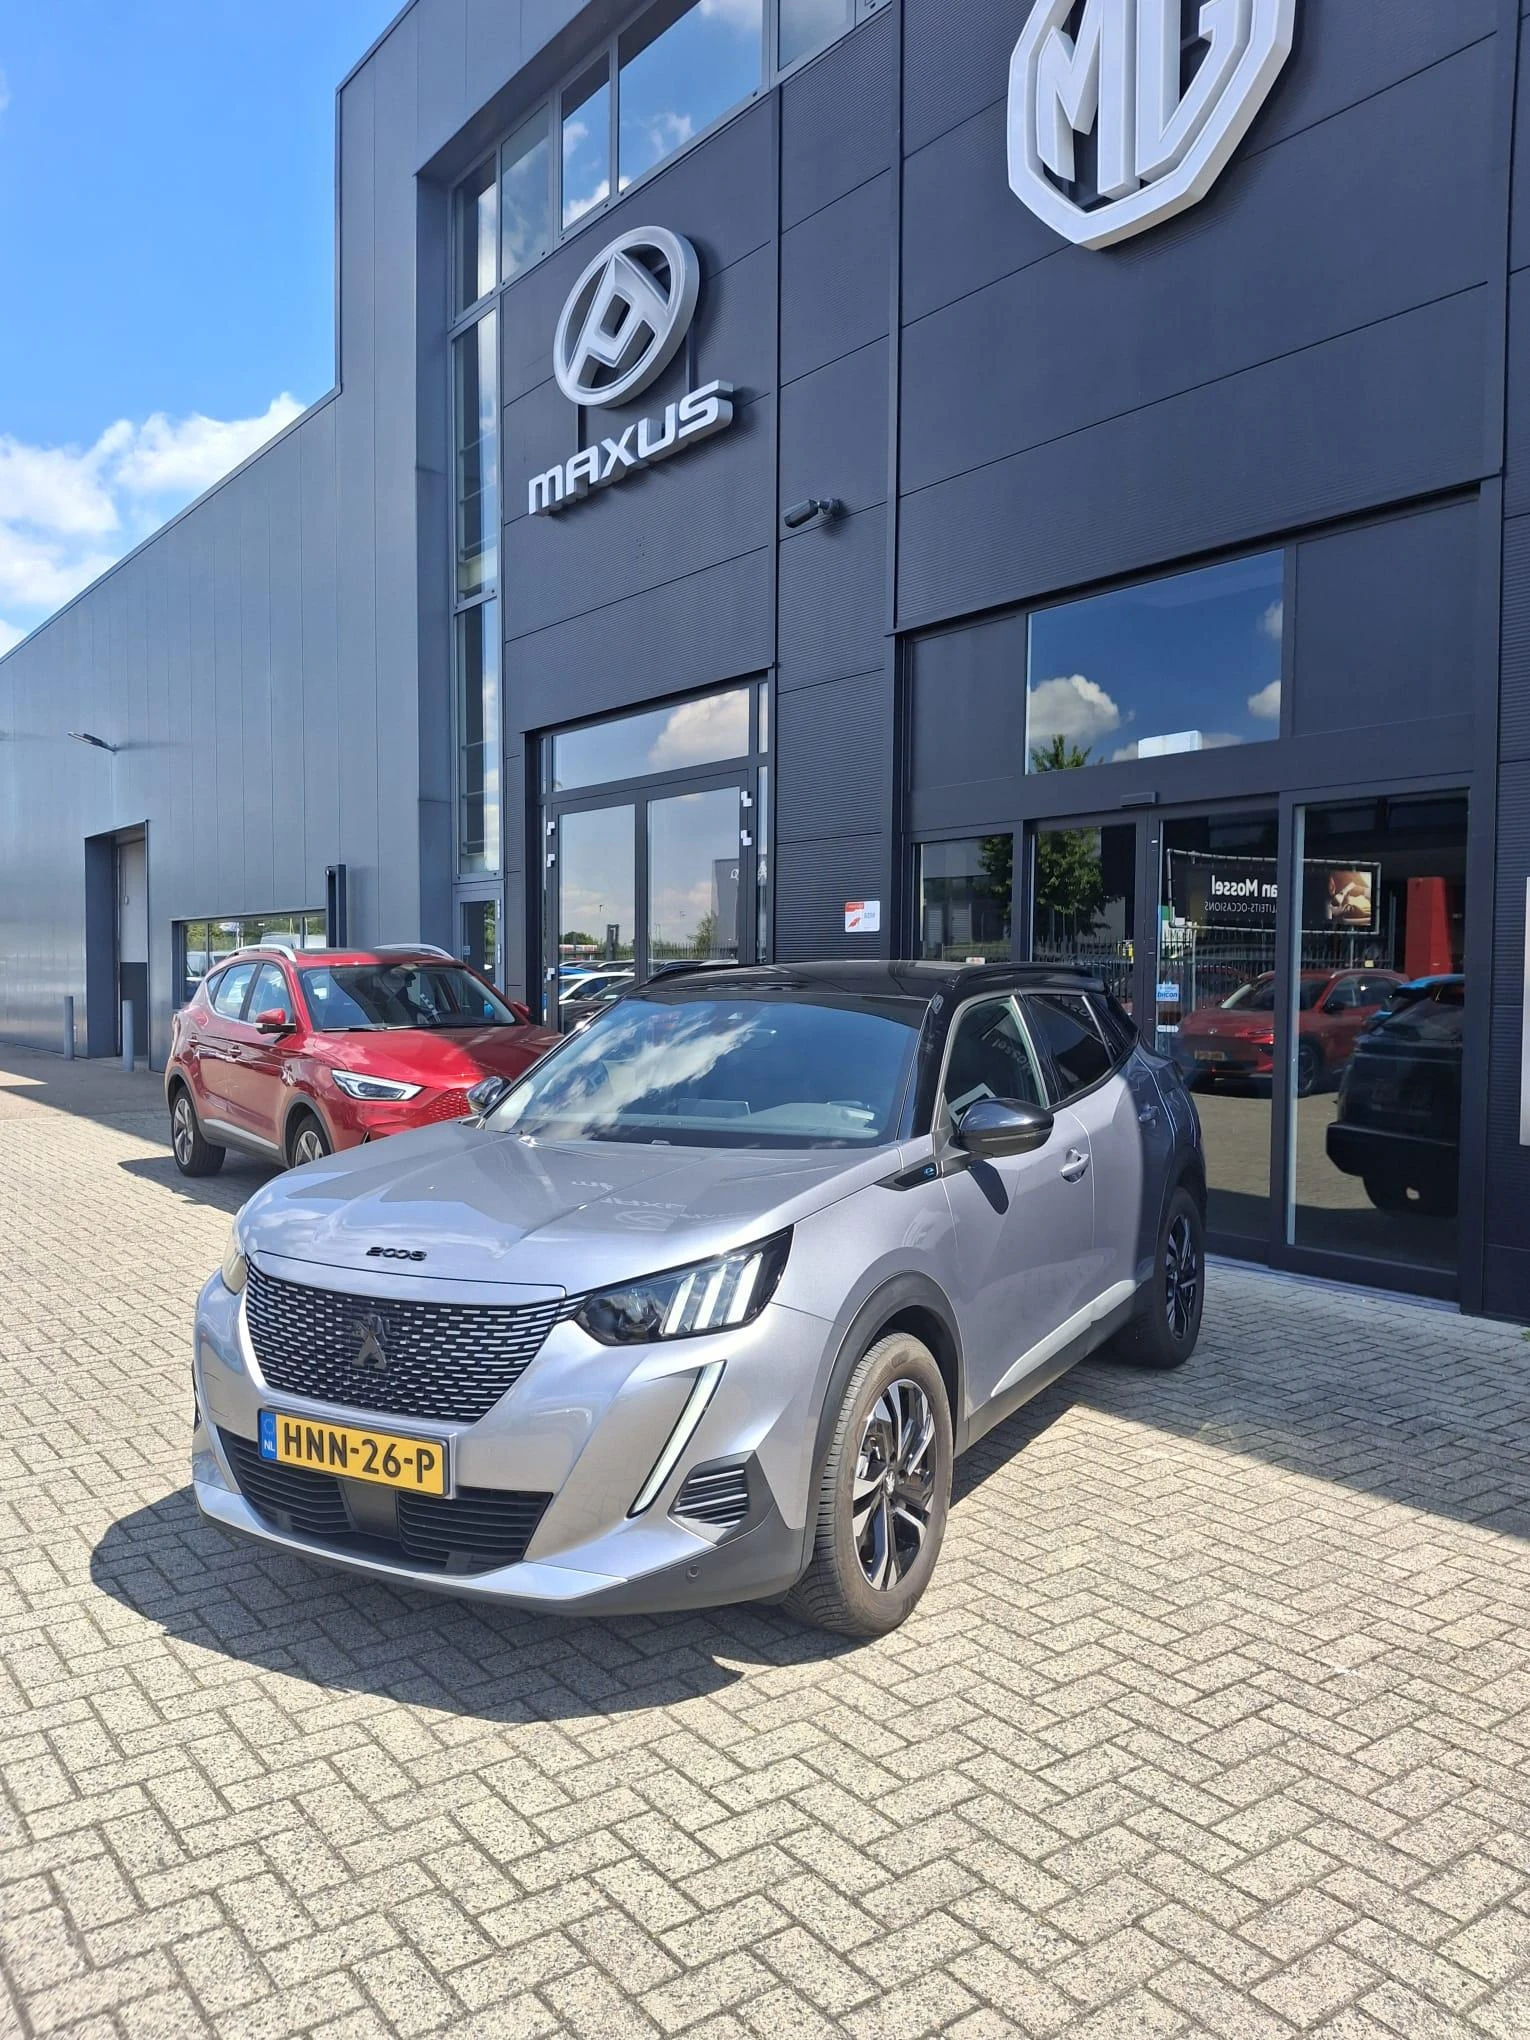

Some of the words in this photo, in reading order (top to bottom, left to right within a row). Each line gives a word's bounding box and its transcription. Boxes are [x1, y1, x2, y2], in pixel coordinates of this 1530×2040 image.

[1036, 0, 1252, 200] MG
[529, 379, 733, 515] MAXUS
[366, 1246, 427, 1261] 2008
[264, 1440, 275, 1452] NL
[283, 1422, 434, 1485] HNN-26-P
